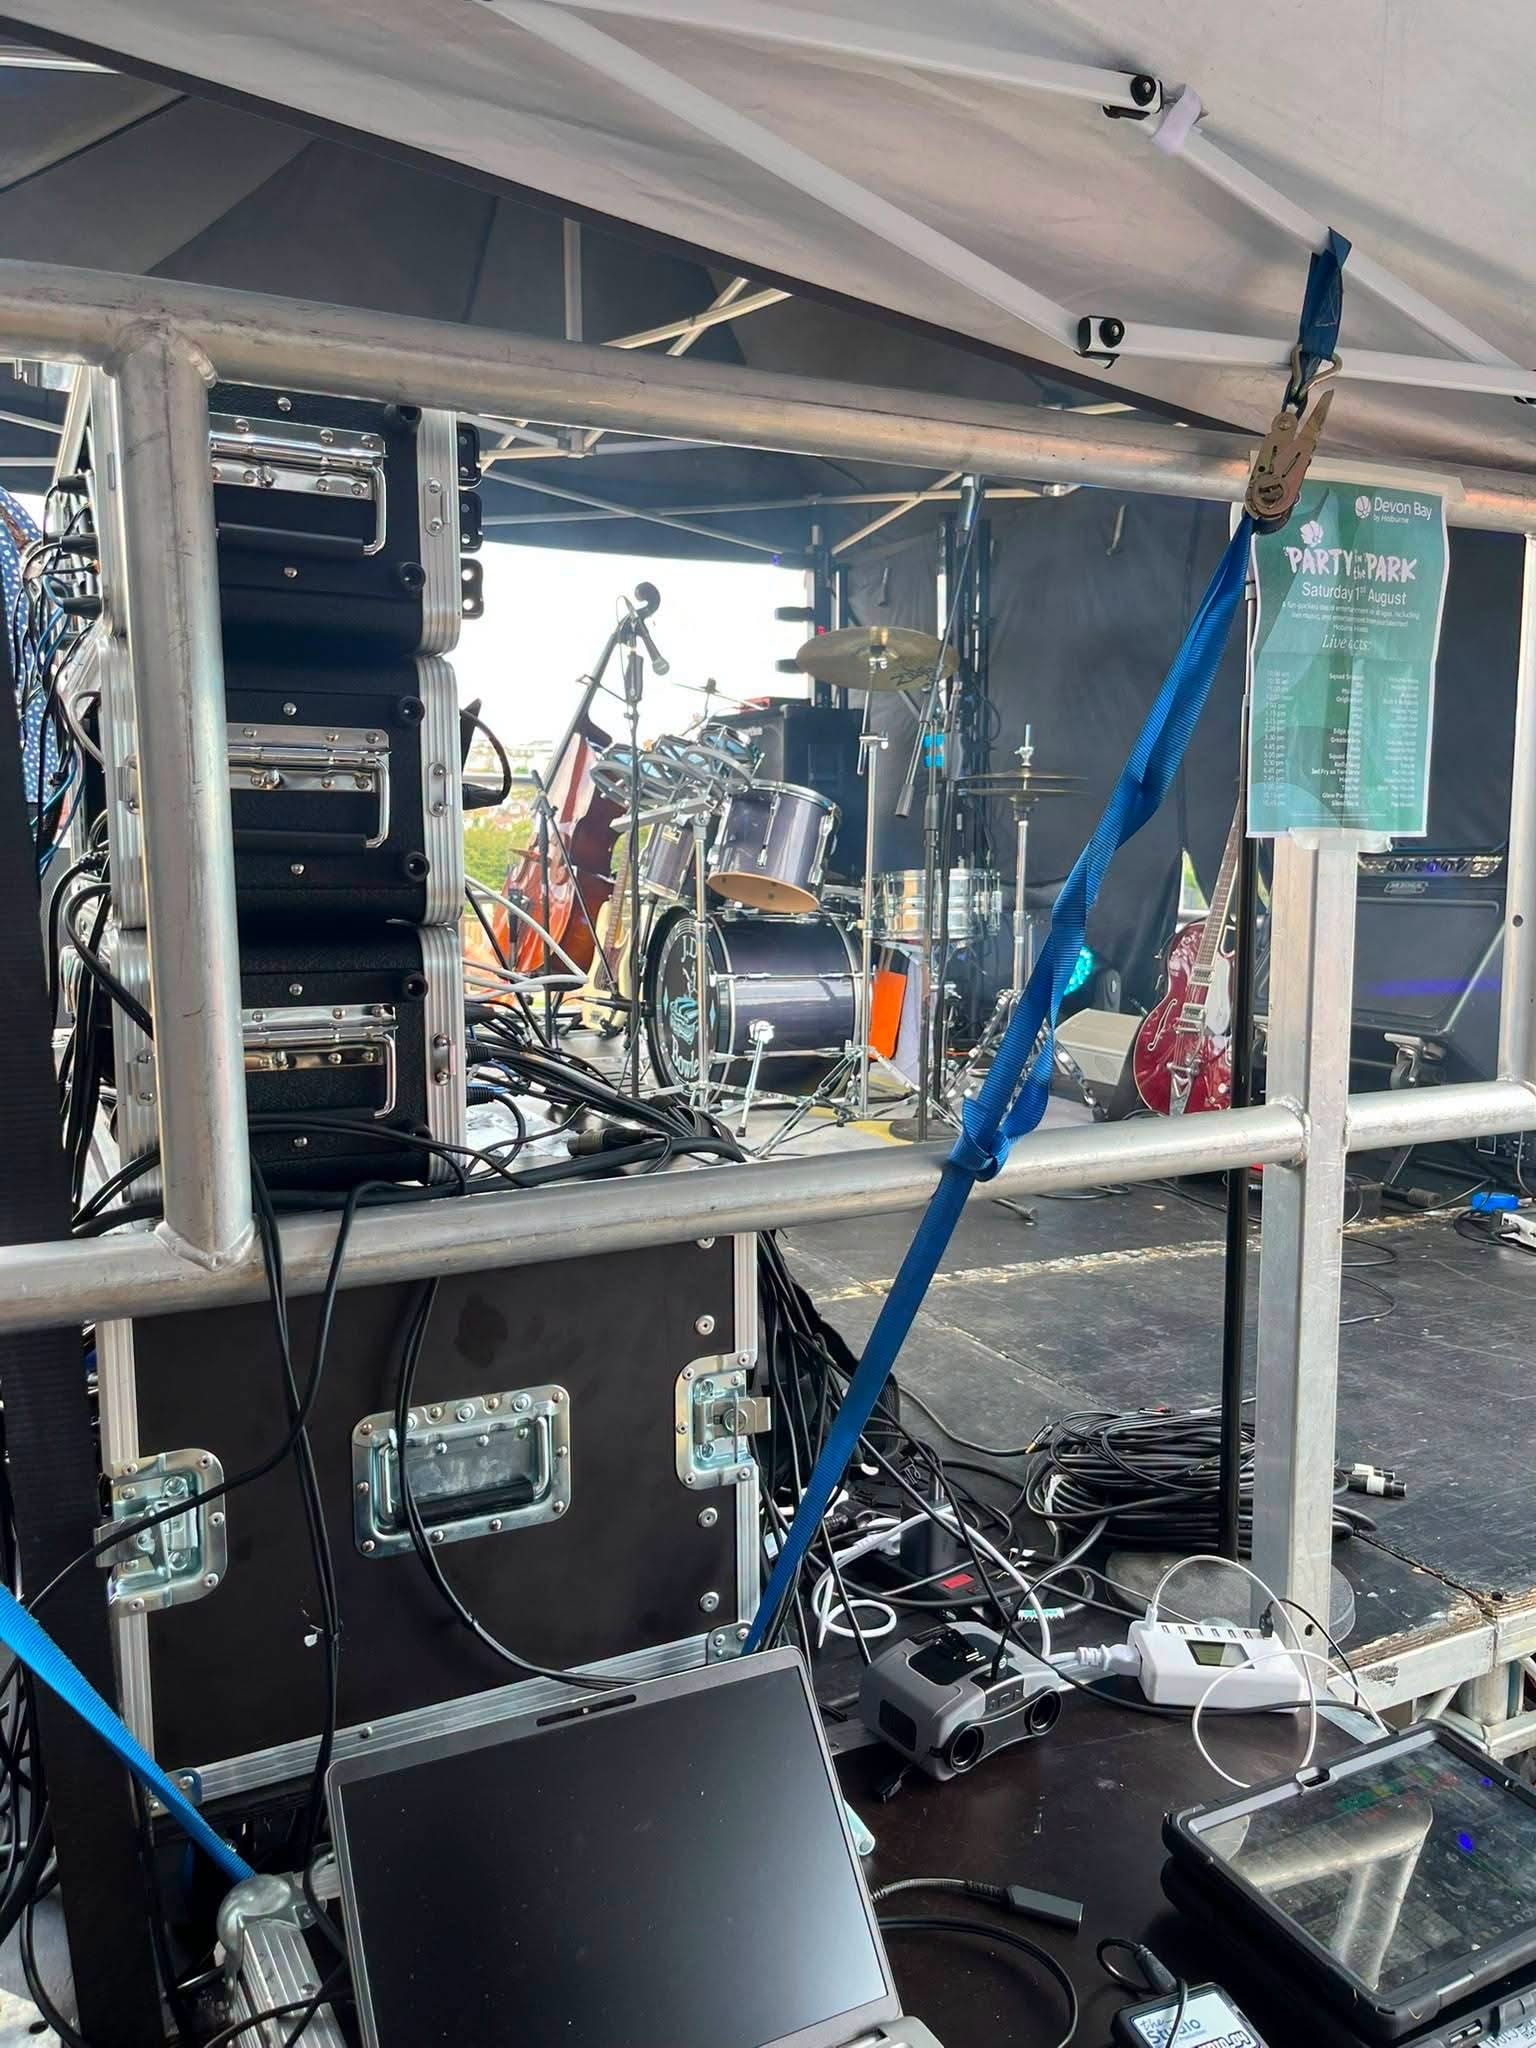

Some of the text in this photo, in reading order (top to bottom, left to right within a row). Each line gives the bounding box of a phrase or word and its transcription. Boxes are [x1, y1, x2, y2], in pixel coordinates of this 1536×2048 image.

[1374, 496, 1432, 521] Devon Bay
[1374, 514, 1380, 523] by
[1288, 546, 1353, 577] PARTY
[1366, 552, 1417, 583] PARK
[1354, 567, 1366, 581] the
[1302, 581, 1407, 608] Saturday 1st August
[1322, 634, 1348, 649] Live
[1140, 2016, 1164, 2031] the
